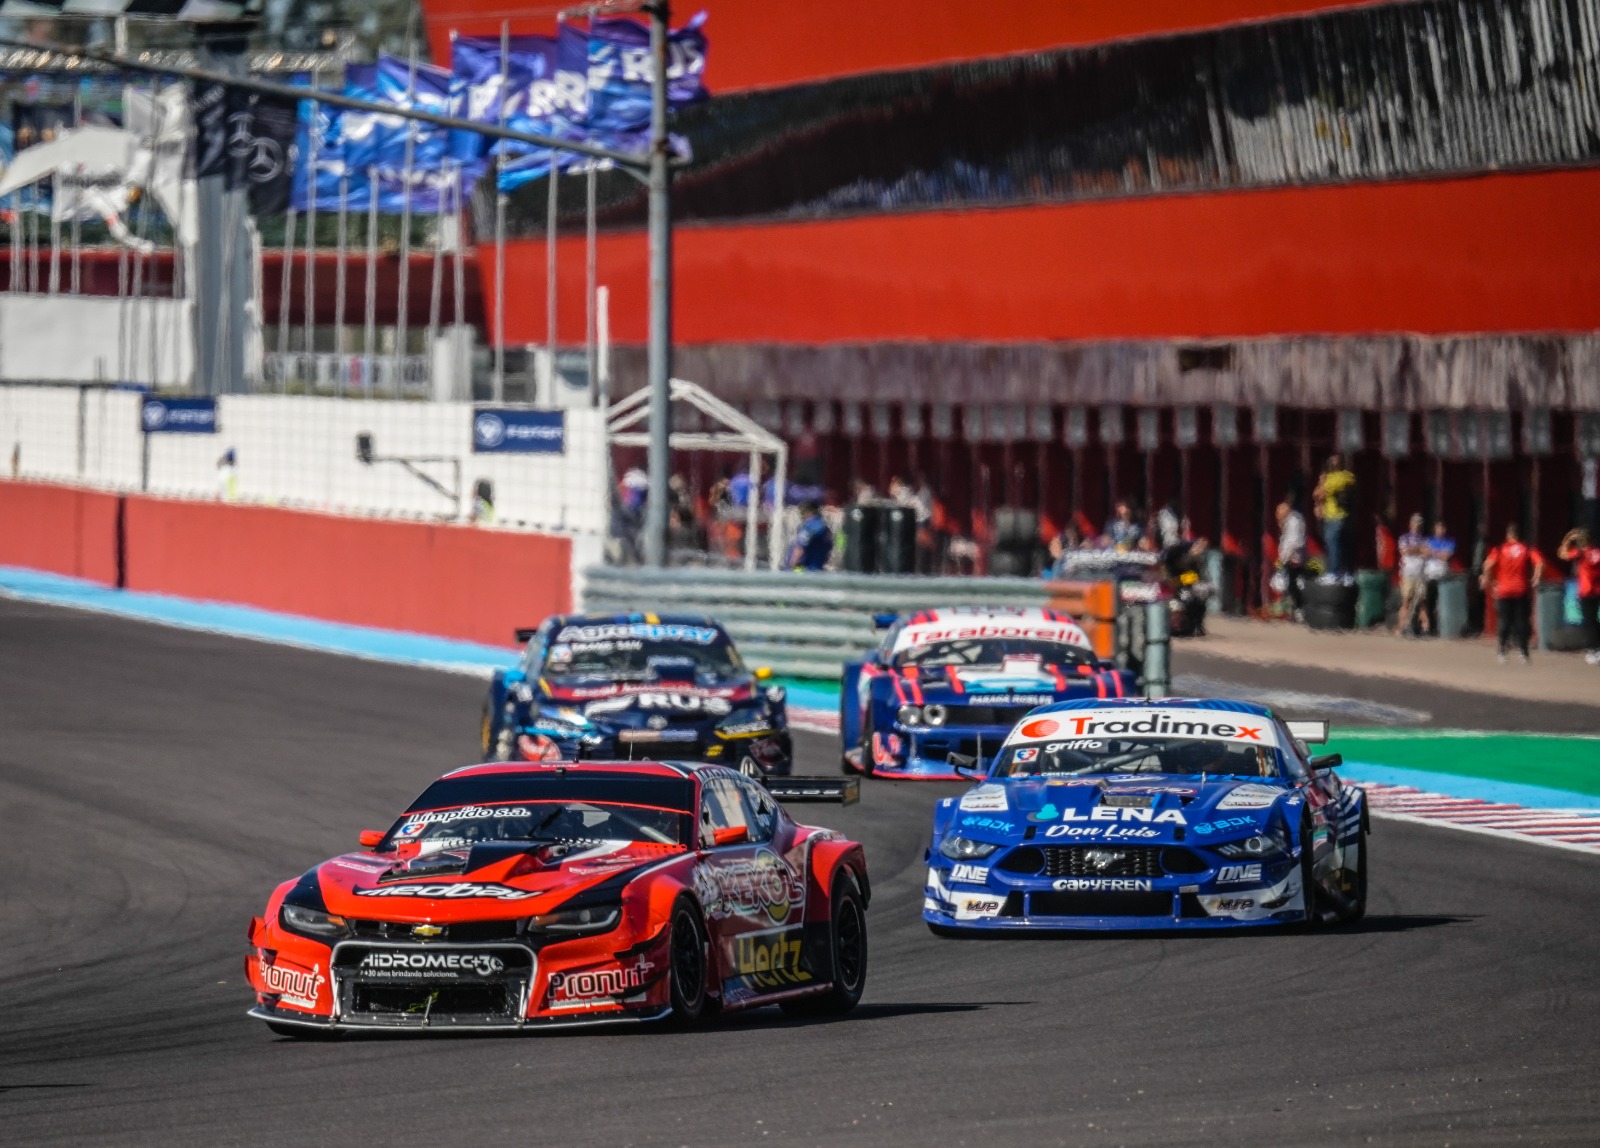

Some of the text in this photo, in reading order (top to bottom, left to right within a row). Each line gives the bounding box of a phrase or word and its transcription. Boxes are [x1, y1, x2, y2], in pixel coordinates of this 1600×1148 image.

[907, 625, 1082, 645] Taraborelli
[1069, 713, 1263, 741] Tradimex
[1045, 739, 1103, 754] griffo
[1062, 806, 1188, 825] LENA
[1045, 824, 1161, 838] Don Luis
[950, 864, 989, 882] ONE
[1217, 863, 1262, 881] ONE
[391, 969, 423, 978] brindando
[547, 955, 652, 998] Pronut
